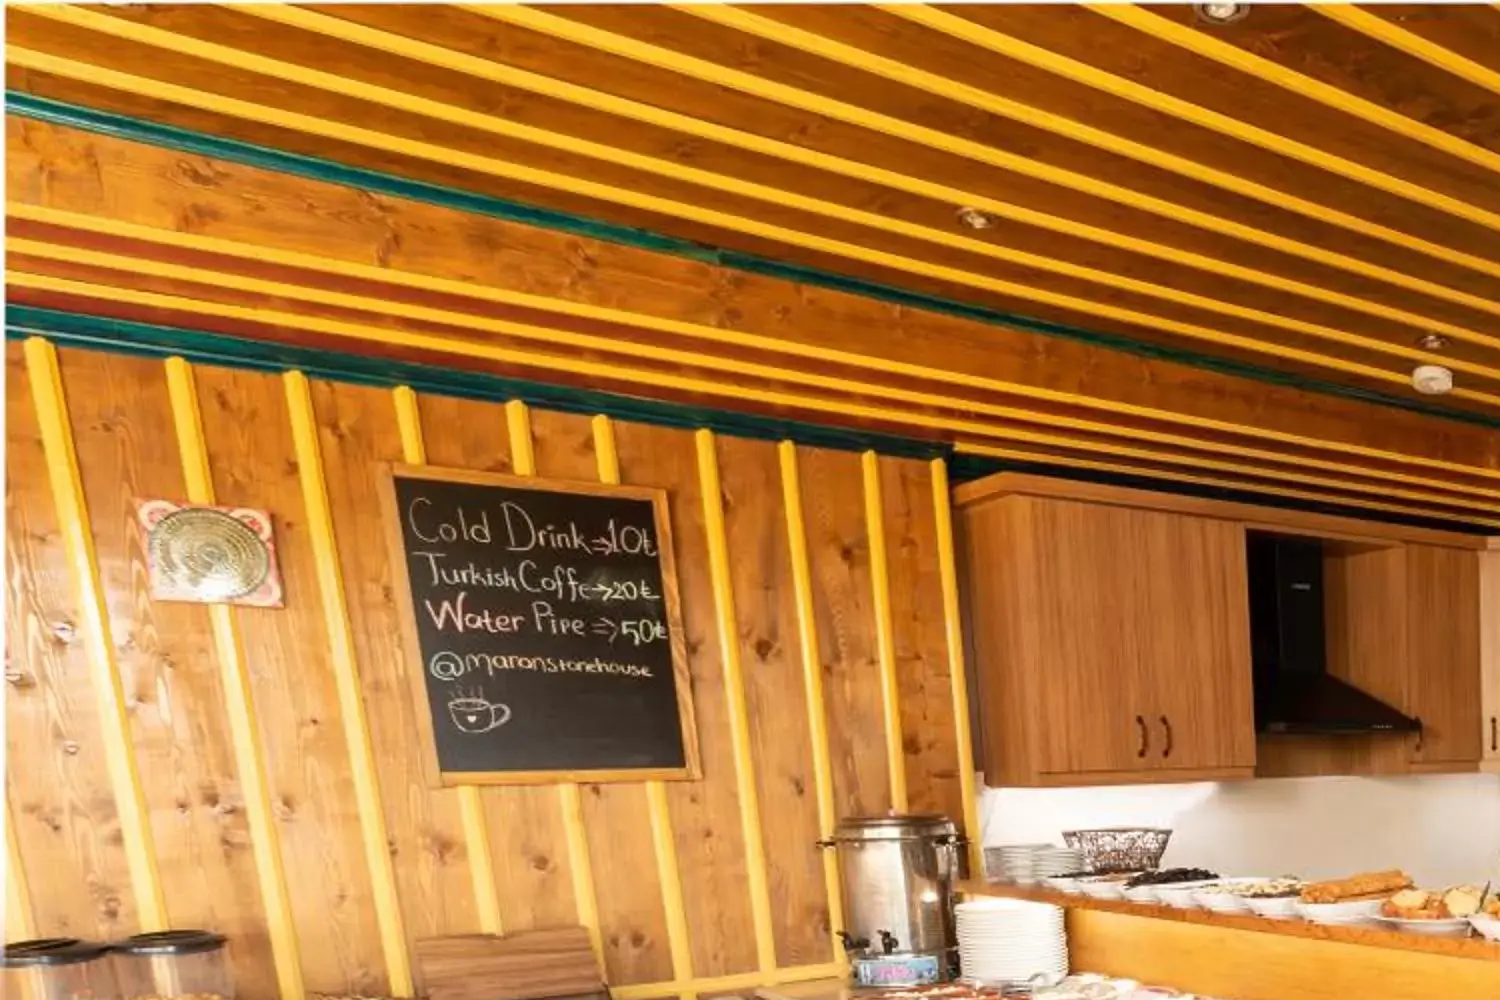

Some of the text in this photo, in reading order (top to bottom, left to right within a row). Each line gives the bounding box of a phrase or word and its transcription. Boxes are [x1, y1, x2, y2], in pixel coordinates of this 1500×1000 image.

[409, 497, 491, 543] Cold
[500, 501, 592, 555] Drink
[411, 551, 519, 592] Turkish
[519, 559, 592, 602] Coffe
[425, 591, 524, 633] Water
